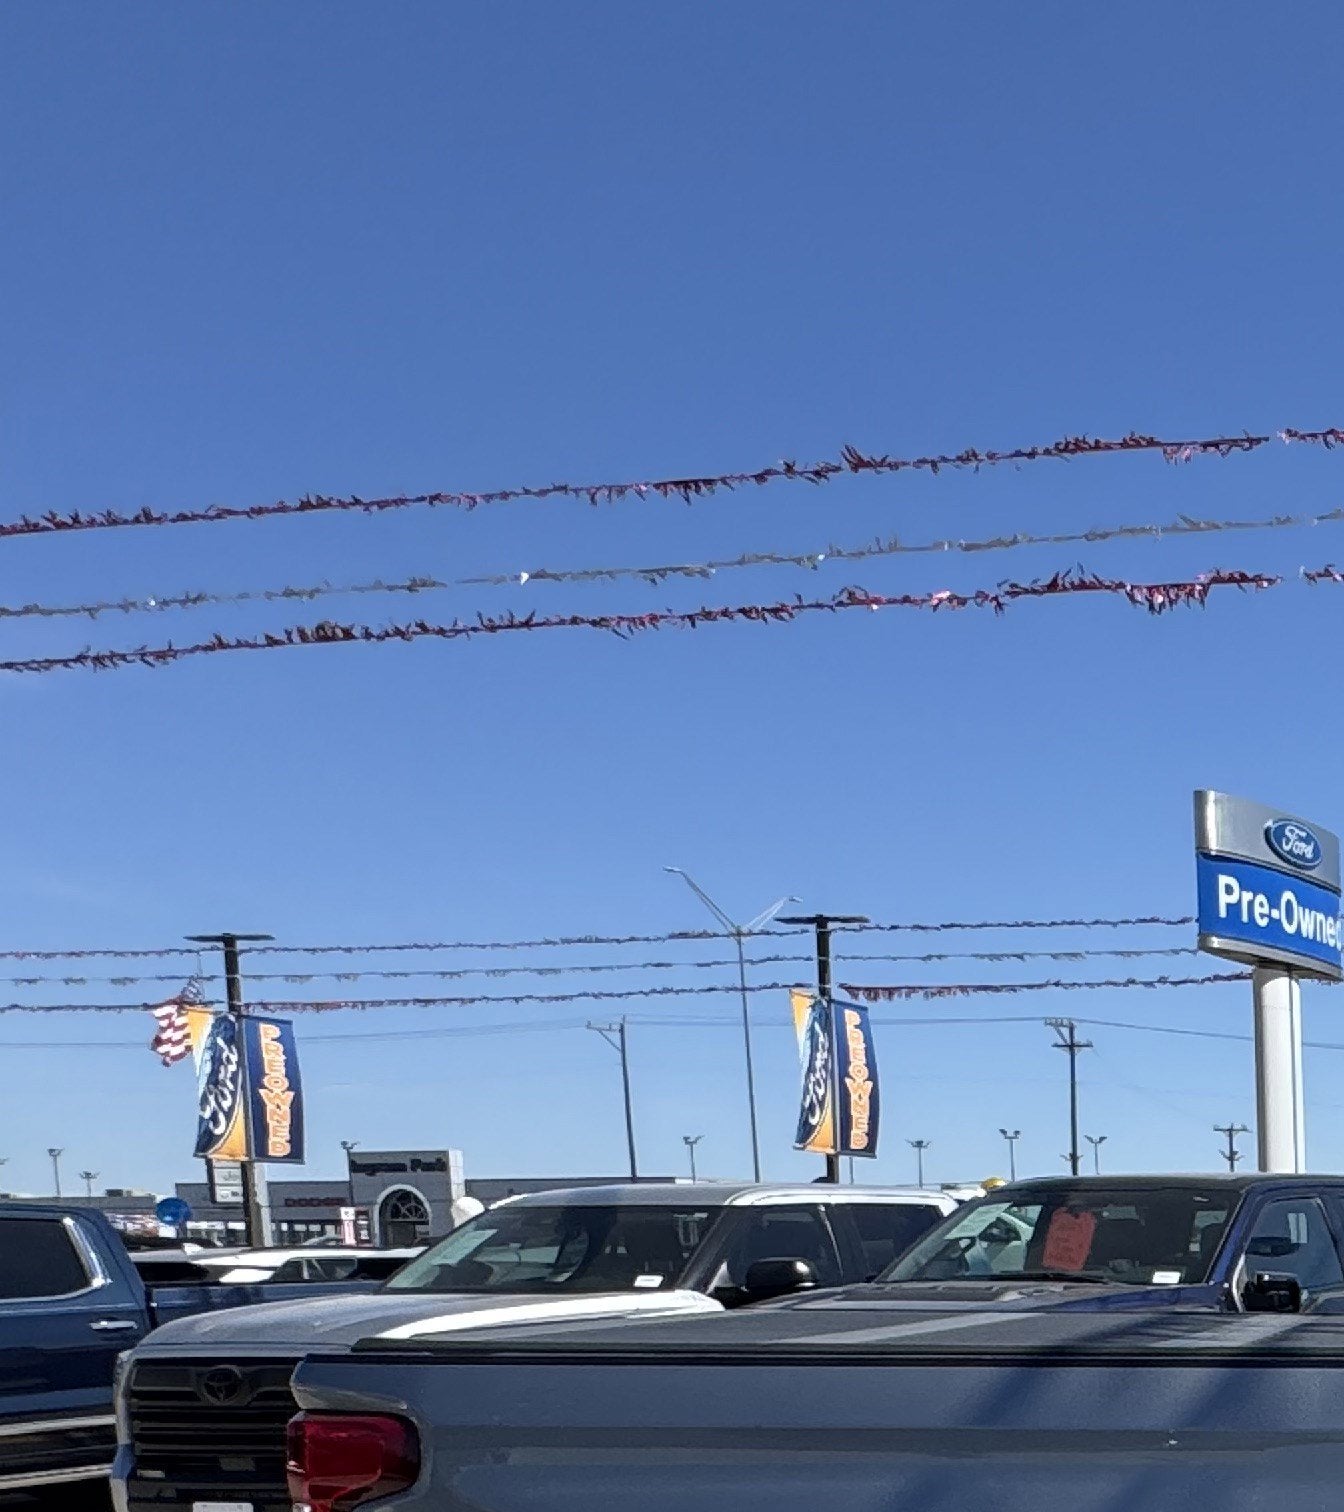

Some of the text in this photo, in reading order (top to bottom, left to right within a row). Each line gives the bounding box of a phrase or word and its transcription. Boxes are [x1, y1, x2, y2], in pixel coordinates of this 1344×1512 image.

[1282, 825, 1314, 859] Ford
[200, 1036, 238, 1136] Ford
[259, 1022, 295, 1156] PREOWNED
